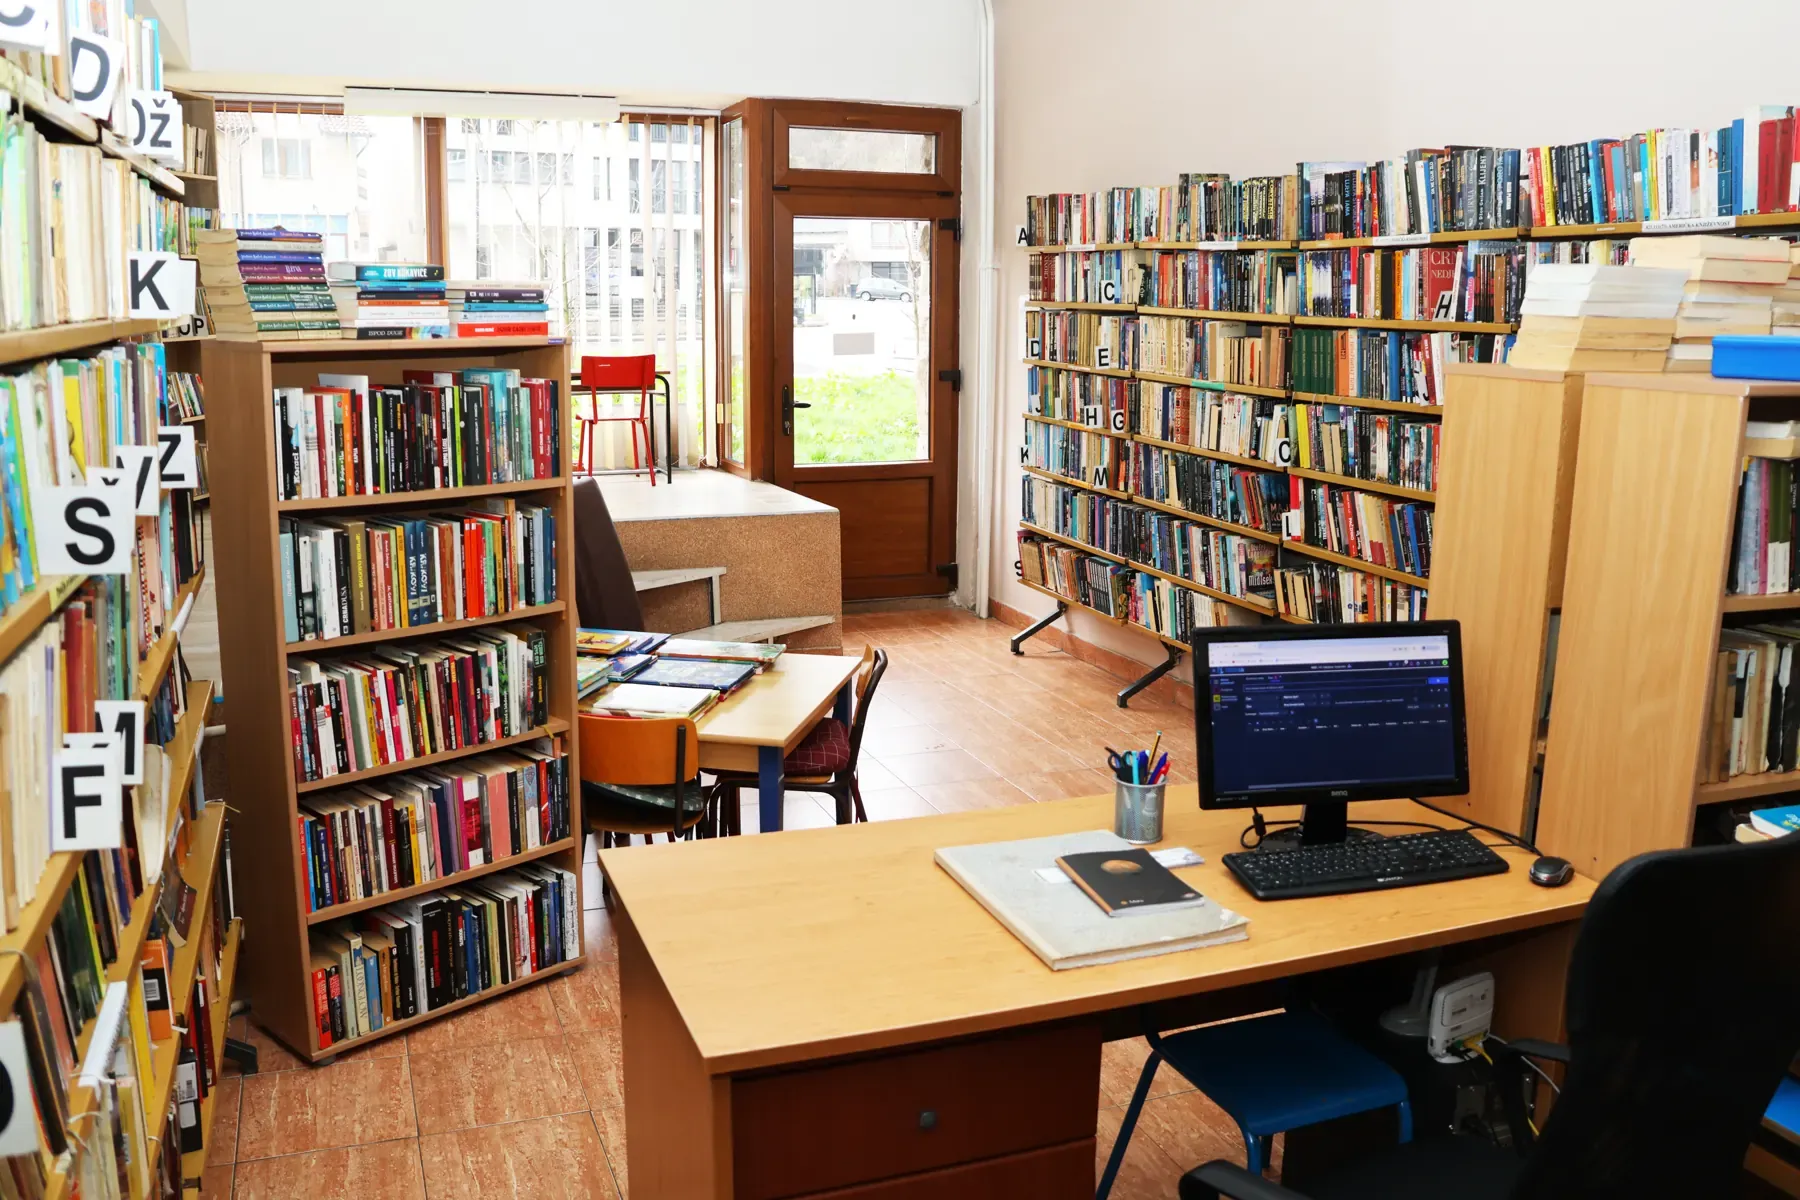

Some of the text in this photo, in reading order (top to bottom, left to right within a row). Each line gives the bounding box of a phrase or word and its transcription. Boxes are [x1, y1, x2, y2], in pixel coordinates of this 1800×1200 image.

[70, 37, 110, 101] D
[1477, 154, 1487, 185] KLIJENT
[1018, 227, 1028, 244] A
[384, 268, 396, 278] ZOV
[129, 259, 169, 311] K
[1104, 282, 1115, 301] C
[1435, 294, 1452, 319] H
[193, 317, 204, 335] P
[1098, 348, 1109, 367] E
[1086, 407, 1097, 426] H
[1113, 412, 1124, 431] G
[158, 434, 185, 481] Z
[1020, 447, 1029, 463] K
[1278, 441, 1290, 463] C
[1094, 467, 1108, 485] M
[61, 765, 105, 839] F
